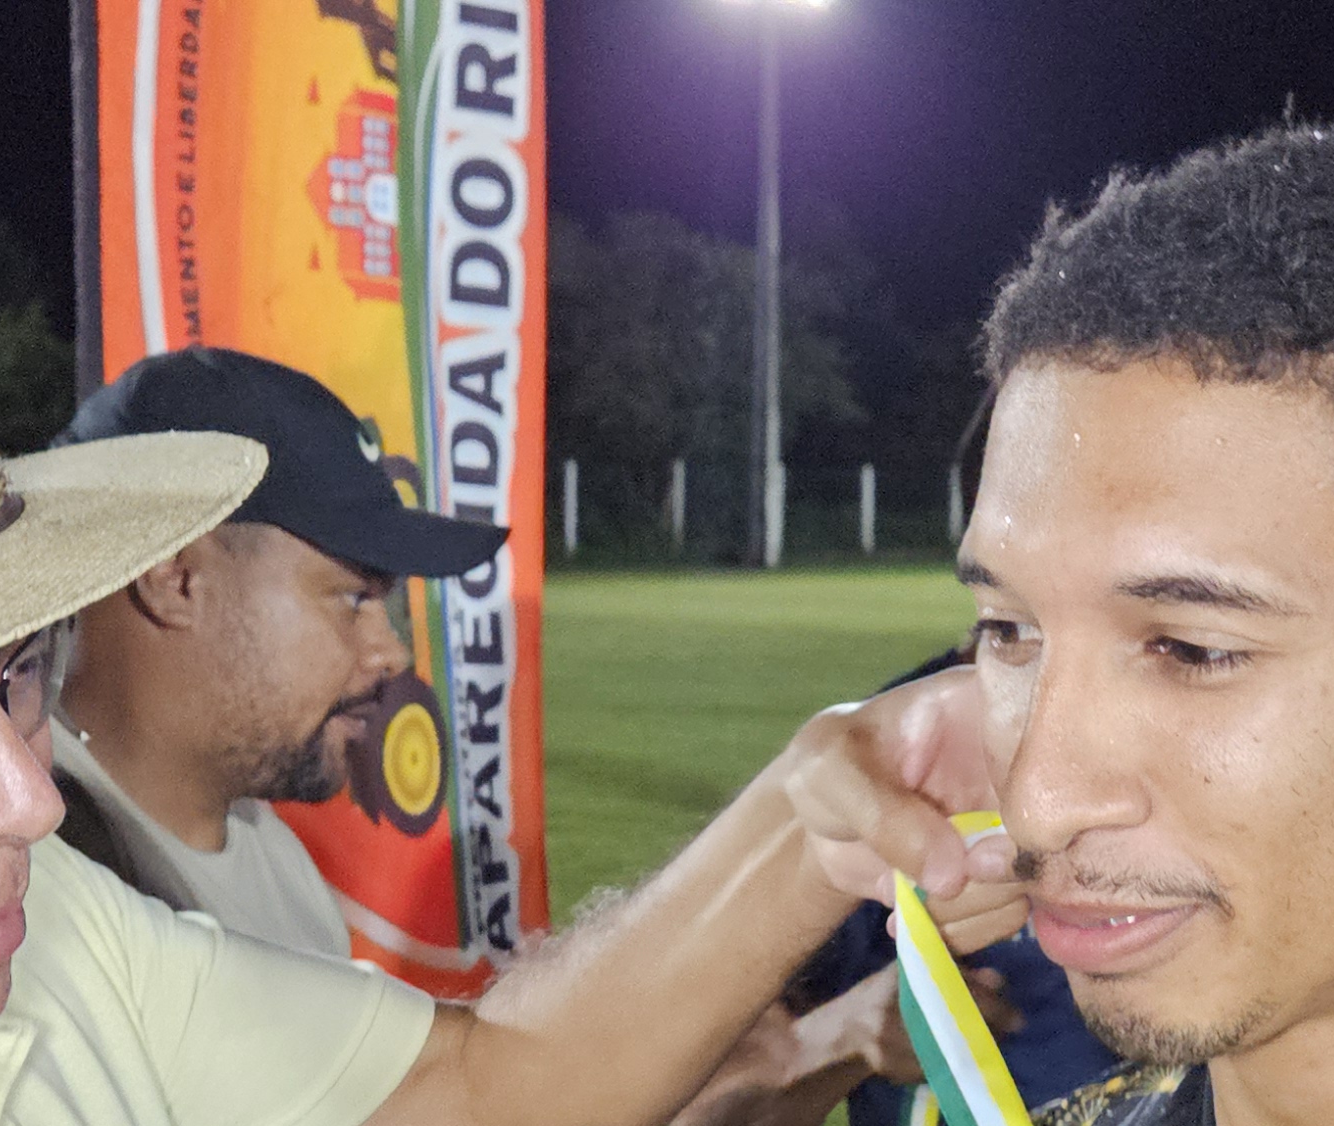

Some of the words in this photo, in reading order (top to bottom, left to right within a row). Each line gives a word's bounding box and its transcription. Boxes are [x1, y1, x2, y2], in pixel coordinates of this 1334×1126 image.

[177, 0, 202, 164] LIBERDA
[177, 204, 202, 344] MENTO
[448, 158, 514, 308] DO
